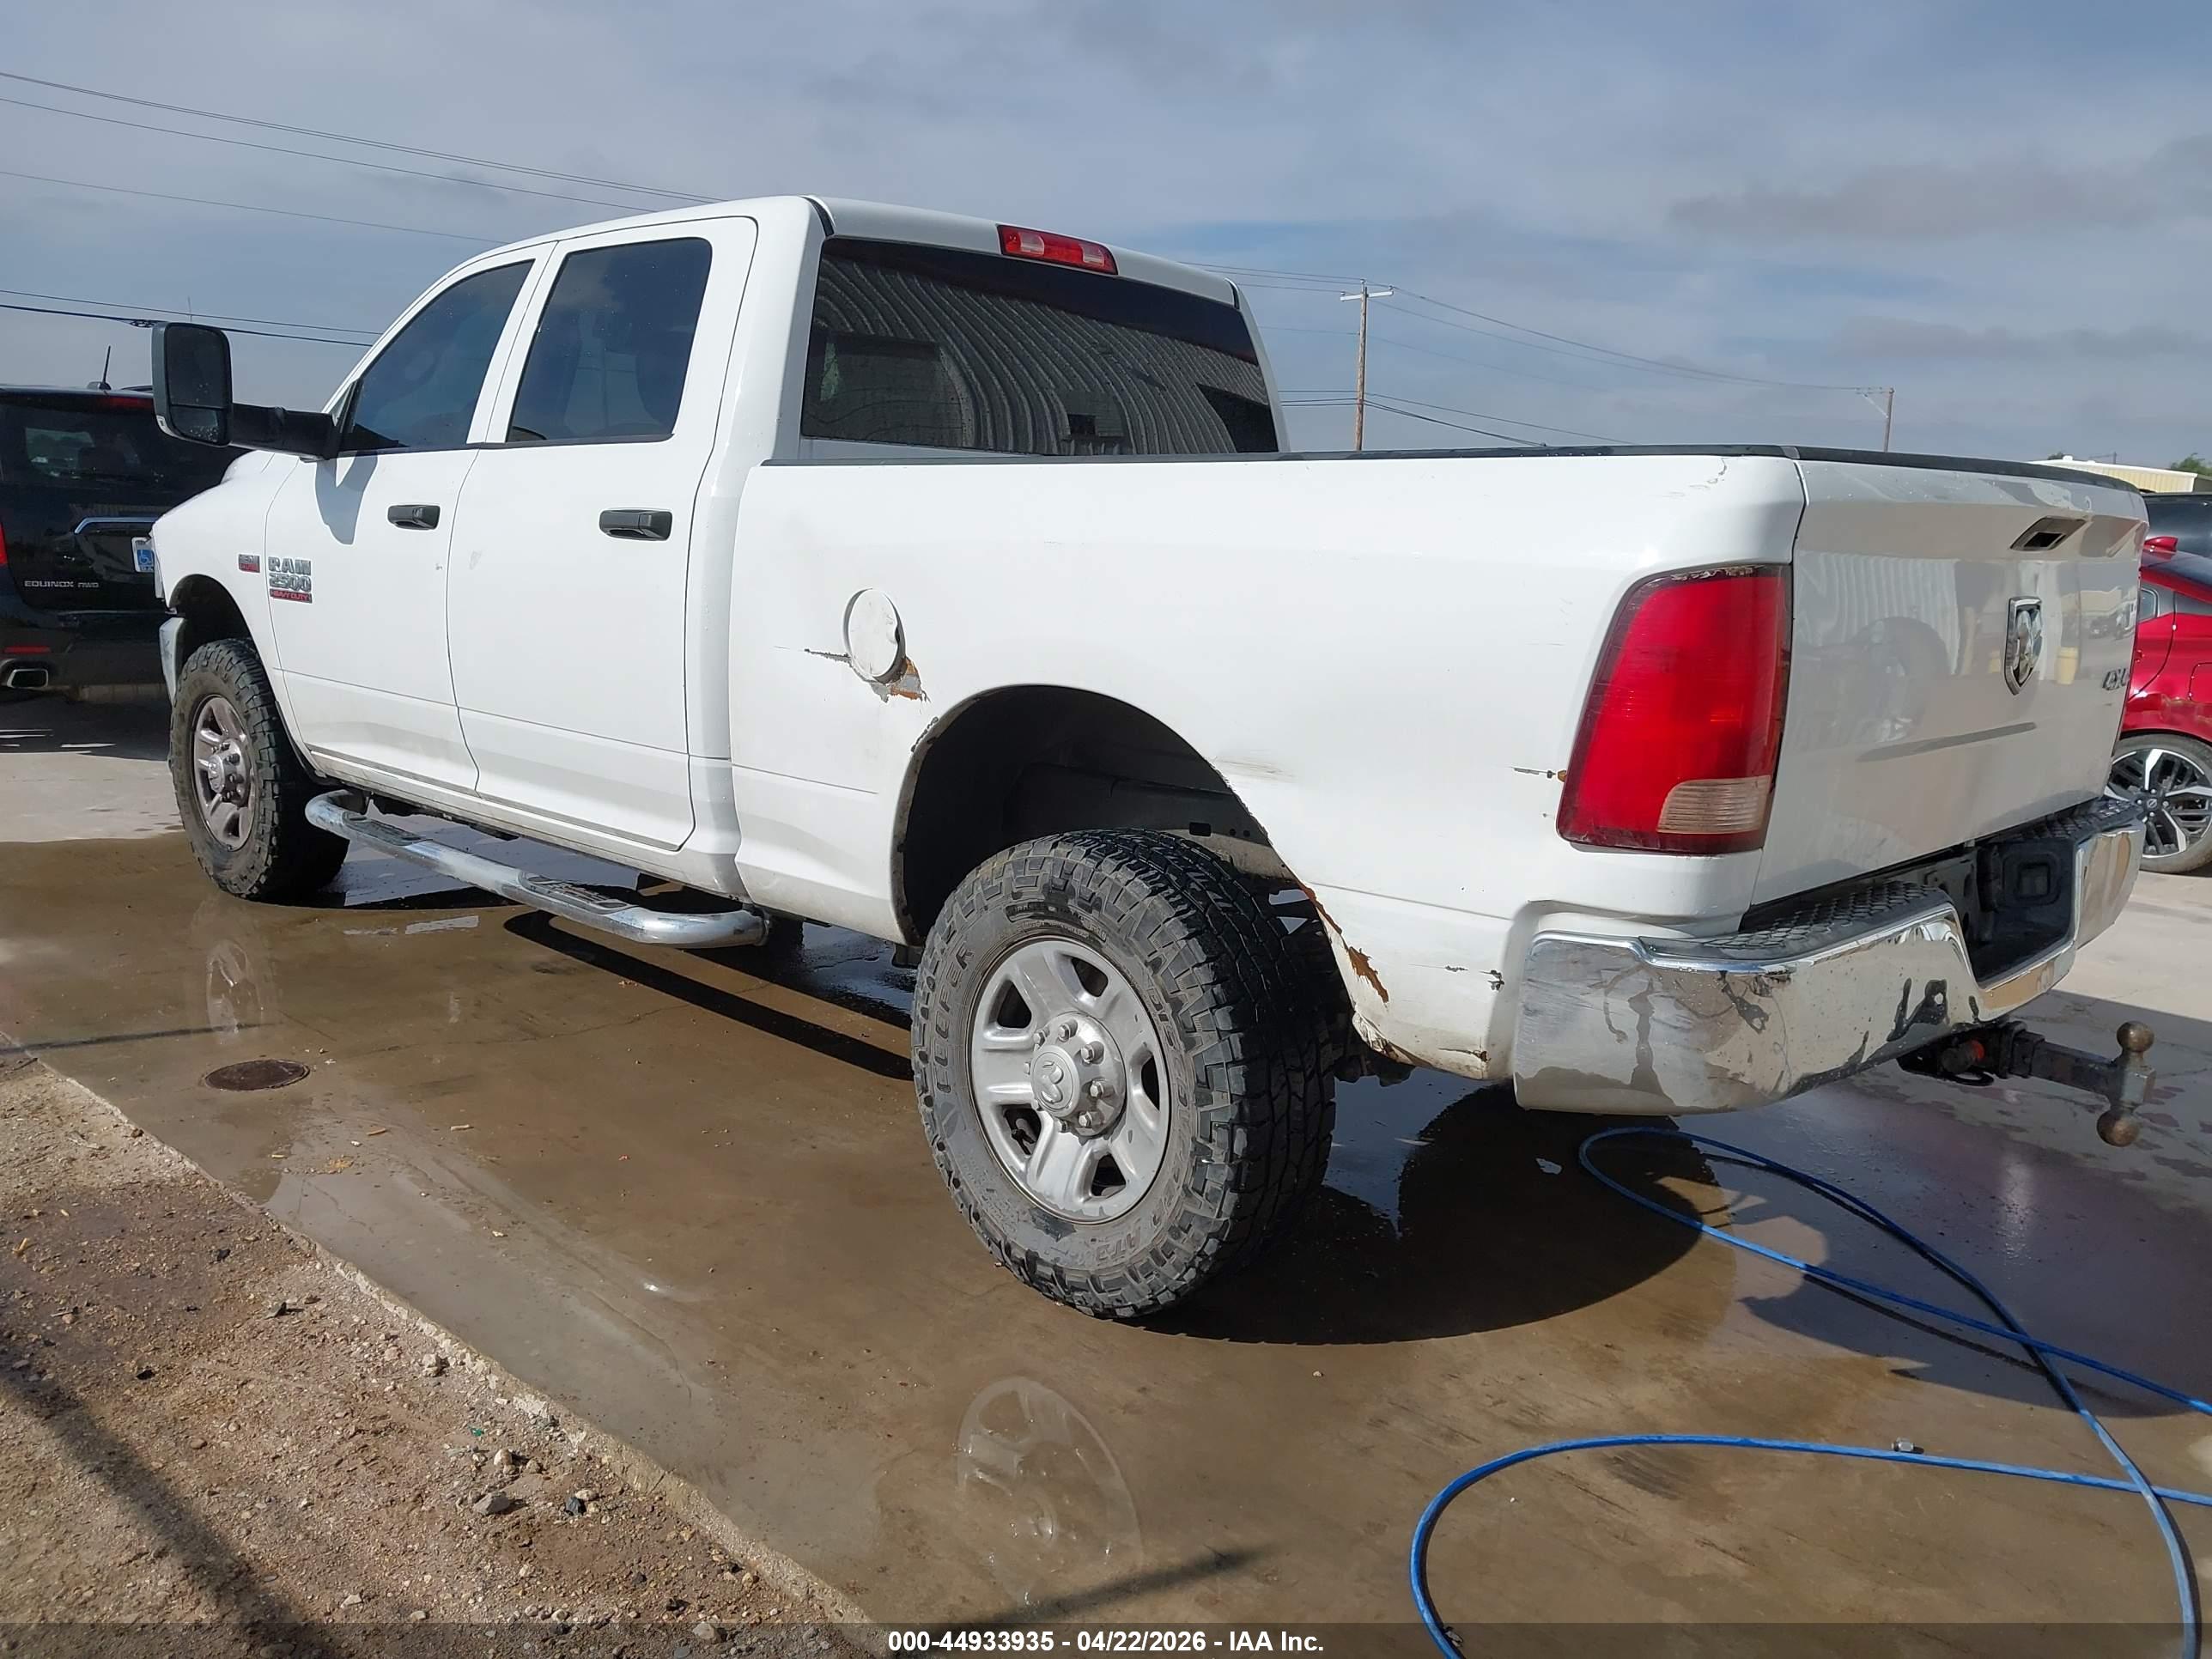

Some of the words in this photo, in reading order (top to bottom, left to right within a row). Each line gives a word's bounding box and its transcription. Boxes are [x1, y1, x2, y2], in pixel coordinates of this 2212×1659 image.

[268, 556, 311, 575] RAM
[269, 572, 311, 592] 2500
[290, 592, 309, 602] DUTY
[933, 945, 974, 1093] COOPER
